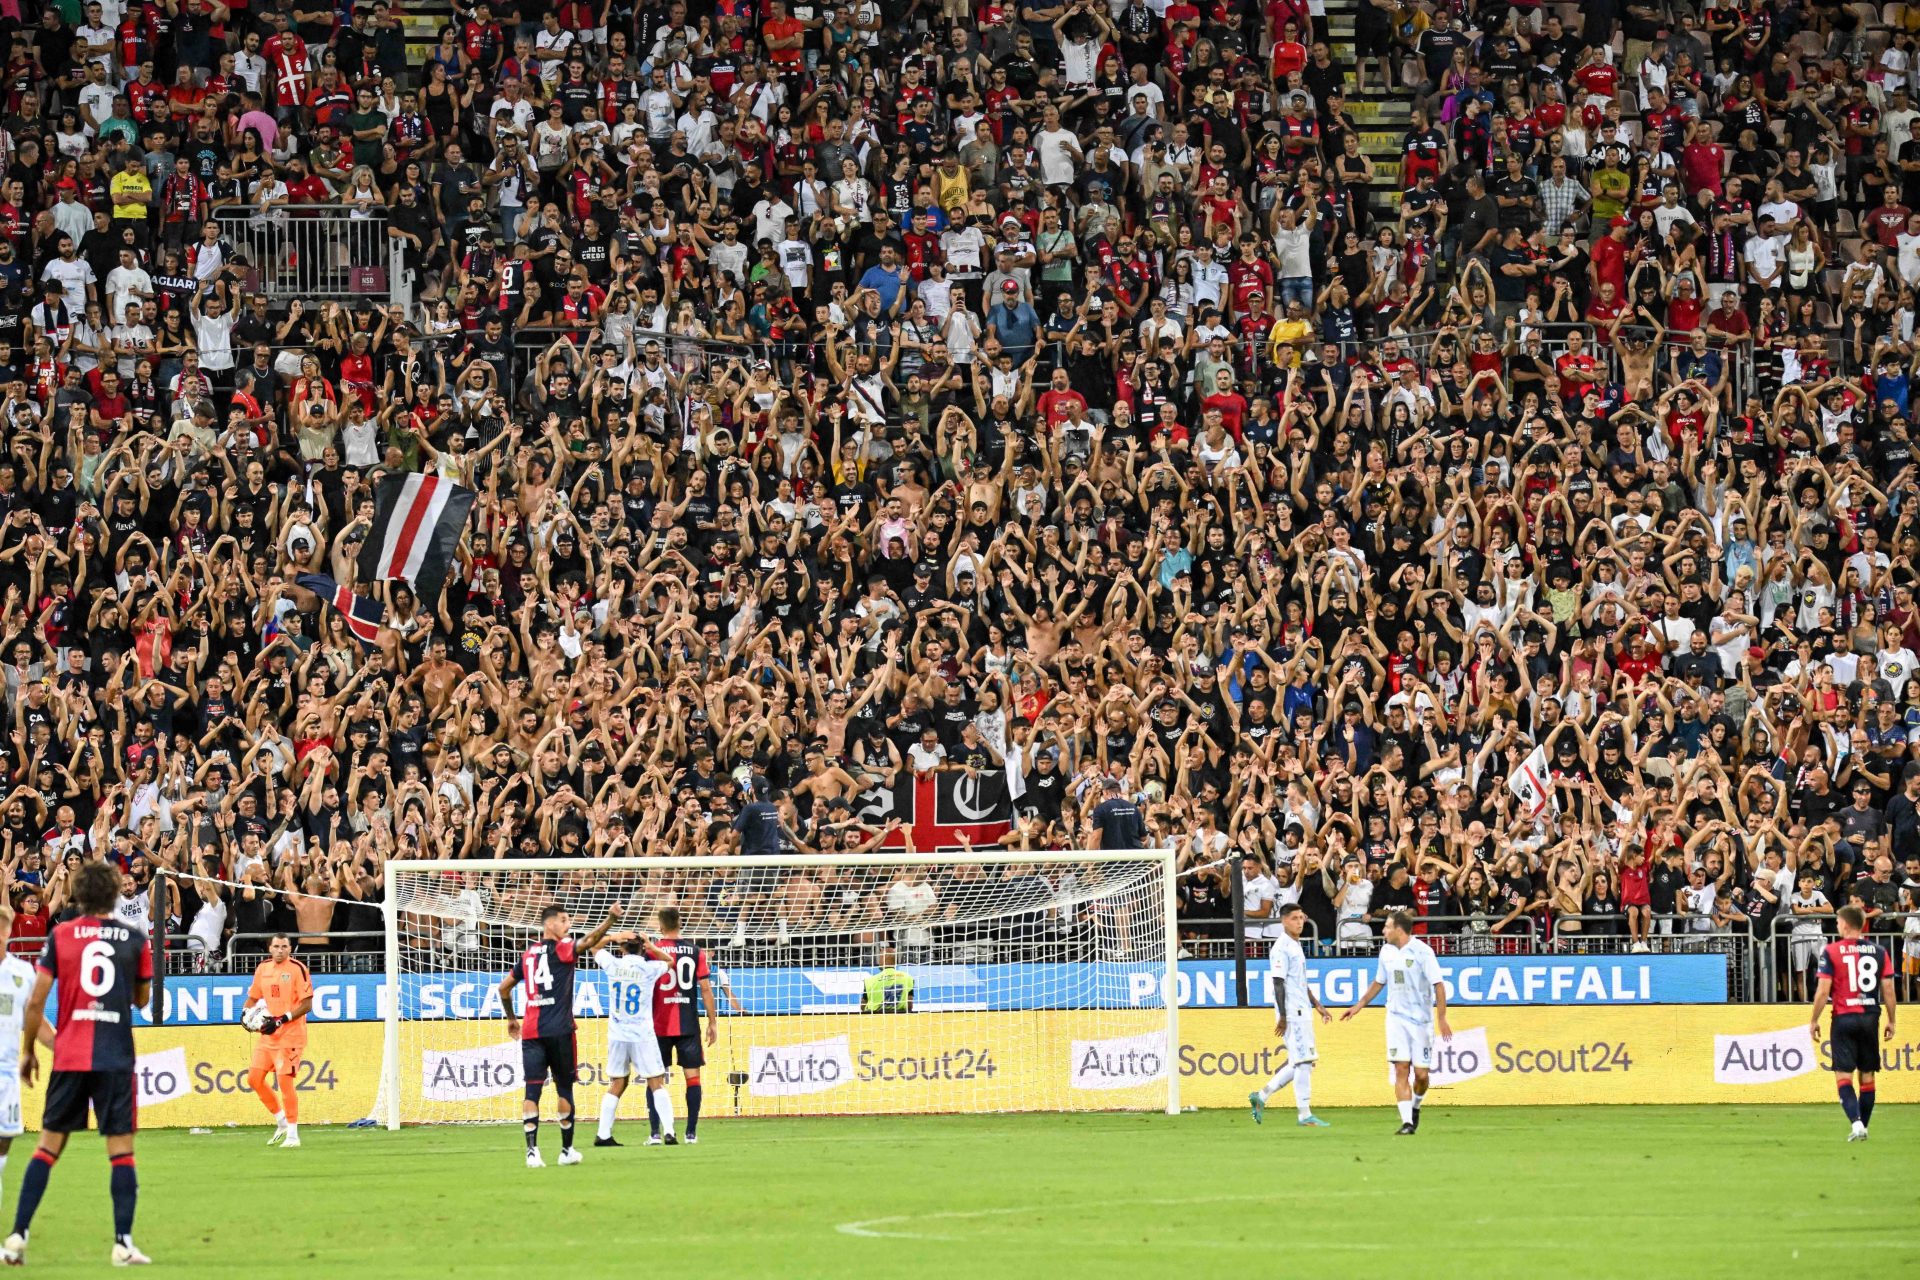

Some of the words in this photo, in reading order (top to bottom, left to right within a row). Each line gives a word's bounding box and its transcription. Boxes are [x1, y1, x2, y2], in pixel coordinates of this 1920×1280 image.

[150, 275, 197, 290] AGLIARI
[502, 266, 514, 289] 9
[29, 713, 45, 723] CA
[74, 926, 130, 941] LUPERTO
[80, 940, 116, 997] 6
[525, 952, 555, 995] 14
[1434, 966, 1651, 1001] SCAFFALI
[1842, 955, 1878, 992] 18
[612, 981, 642, 1016] 18
[431, 1057, 515, 1088] Auto
[756, 1052, 841, 1084] Auto
[857, 1048, 998, 1082] Scout24
[1080, 1046, 1161, 1077] Auto
[1179, 1044, 1316, 1077] Scout2
[1429, 1046, 1479, 1074] uto
[1495, 1042, 1633, 1073] Scout24
[1721, 1041, 1804, 1072] Auto
